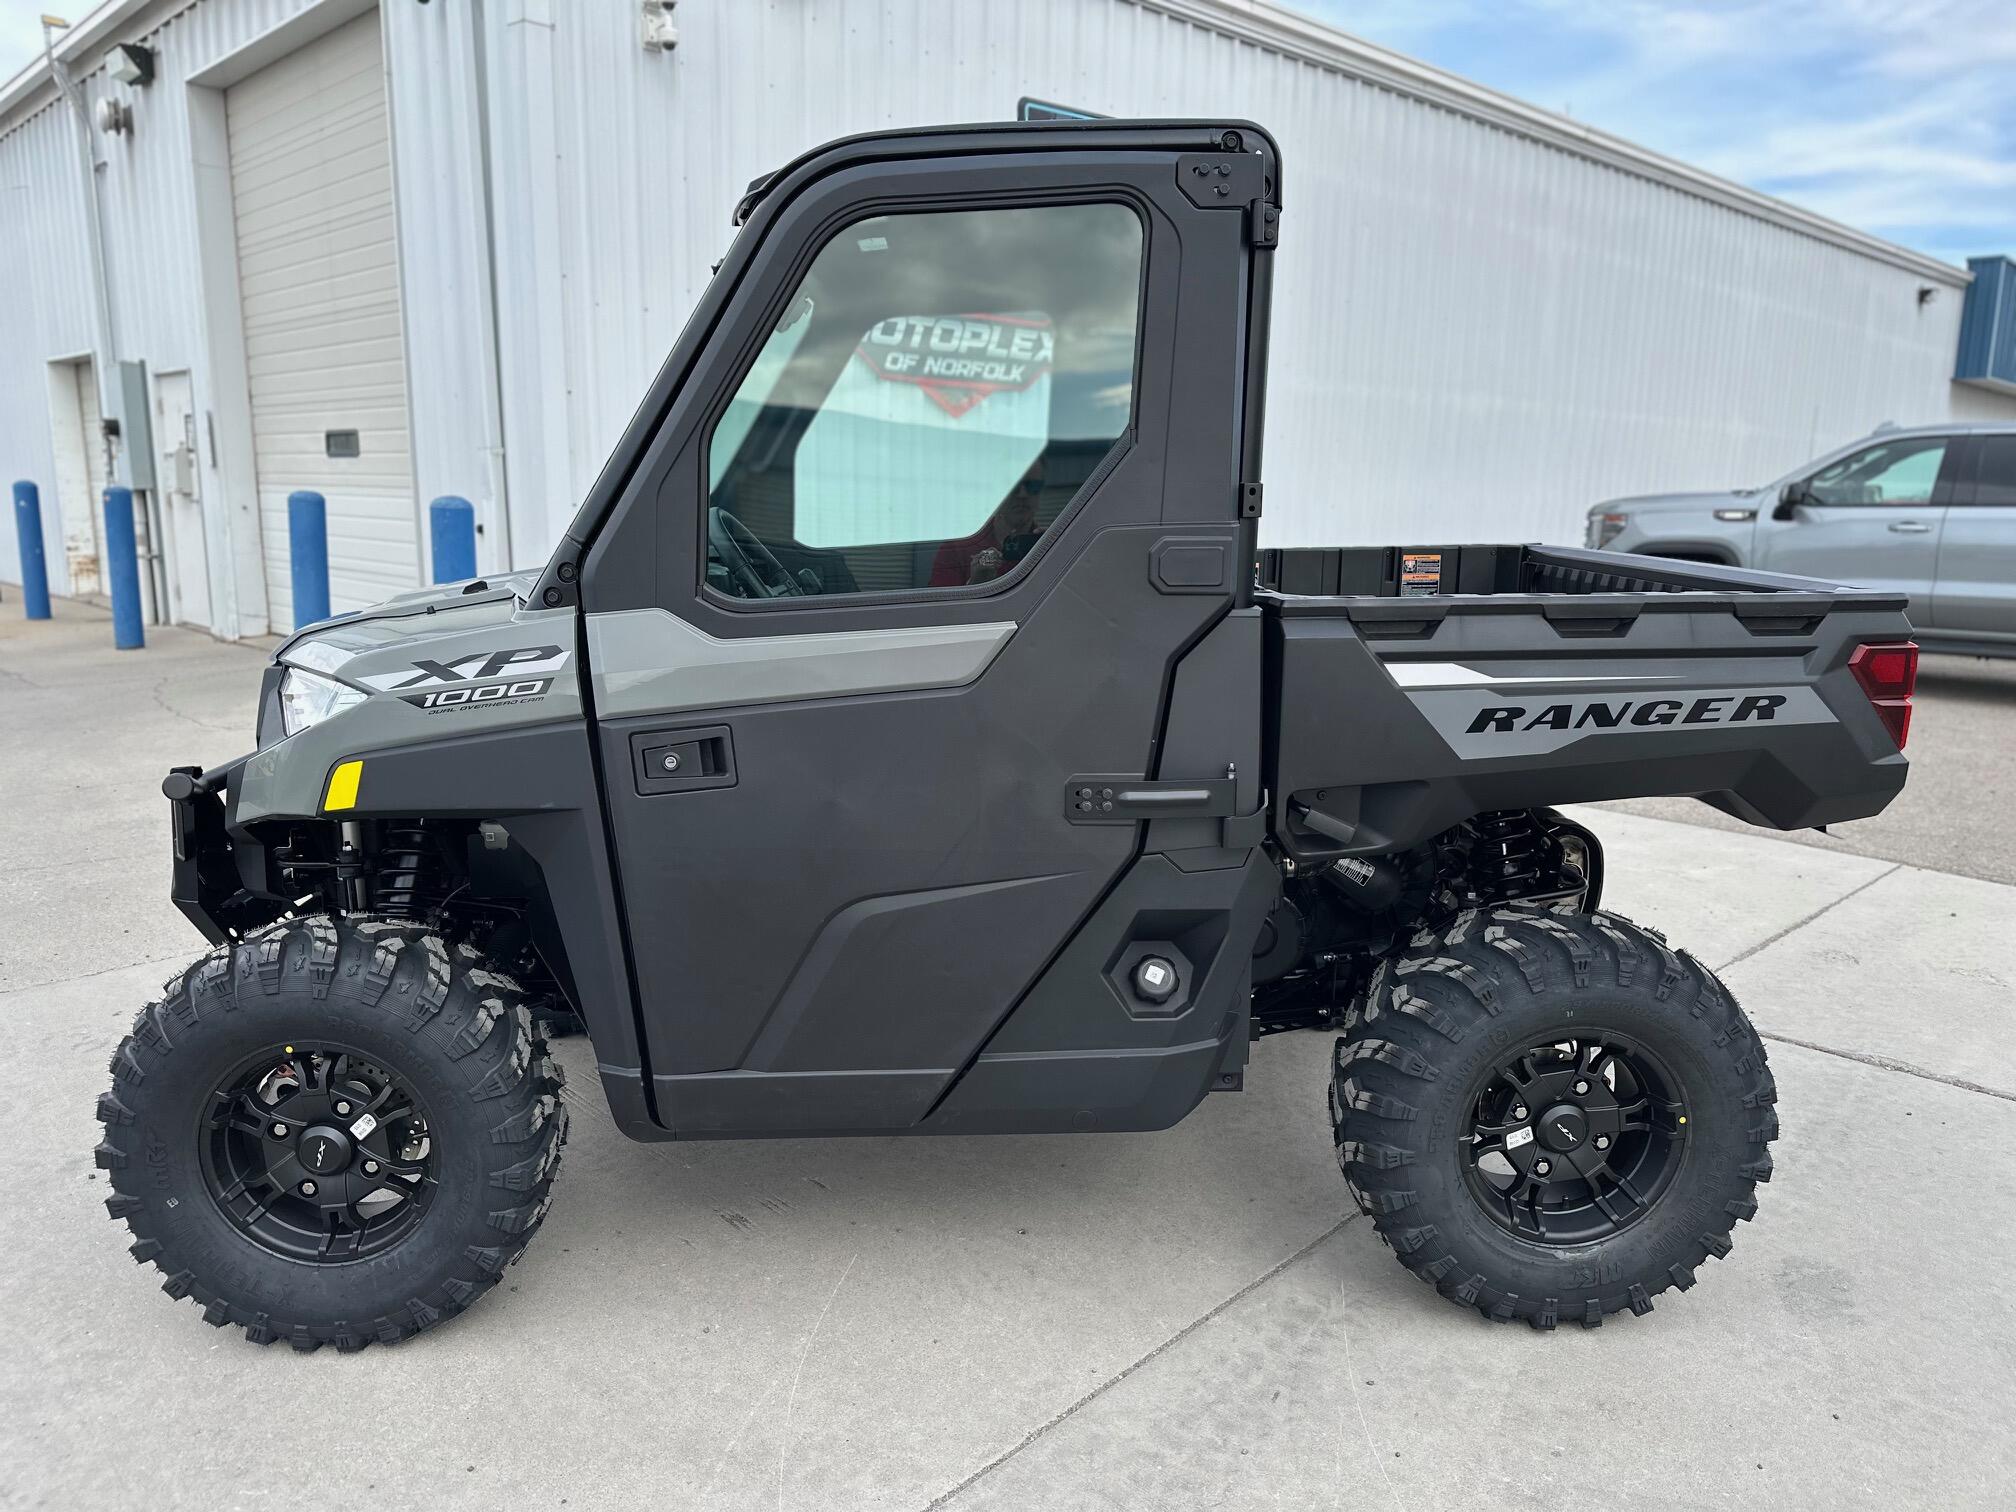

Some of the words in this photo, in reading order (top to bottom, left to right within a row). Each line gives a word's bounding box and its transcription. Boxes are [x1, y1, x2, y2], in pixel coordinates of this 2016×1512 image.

[862, 317, 1053, 363] OTOPLEX
[884, 351, 919, 371] OF
[923, 356, 1026, 383] NORFOLK
[388, 645, 564, 689] XP
[424, 680, 543, 707] 1000
[428, 707, 457, 715] DUAL
[459, 700, 519, 711] OVERHEAD
[520, 696, 545, 704] CAM
[1465, 695, 1787, 733] RANGER
